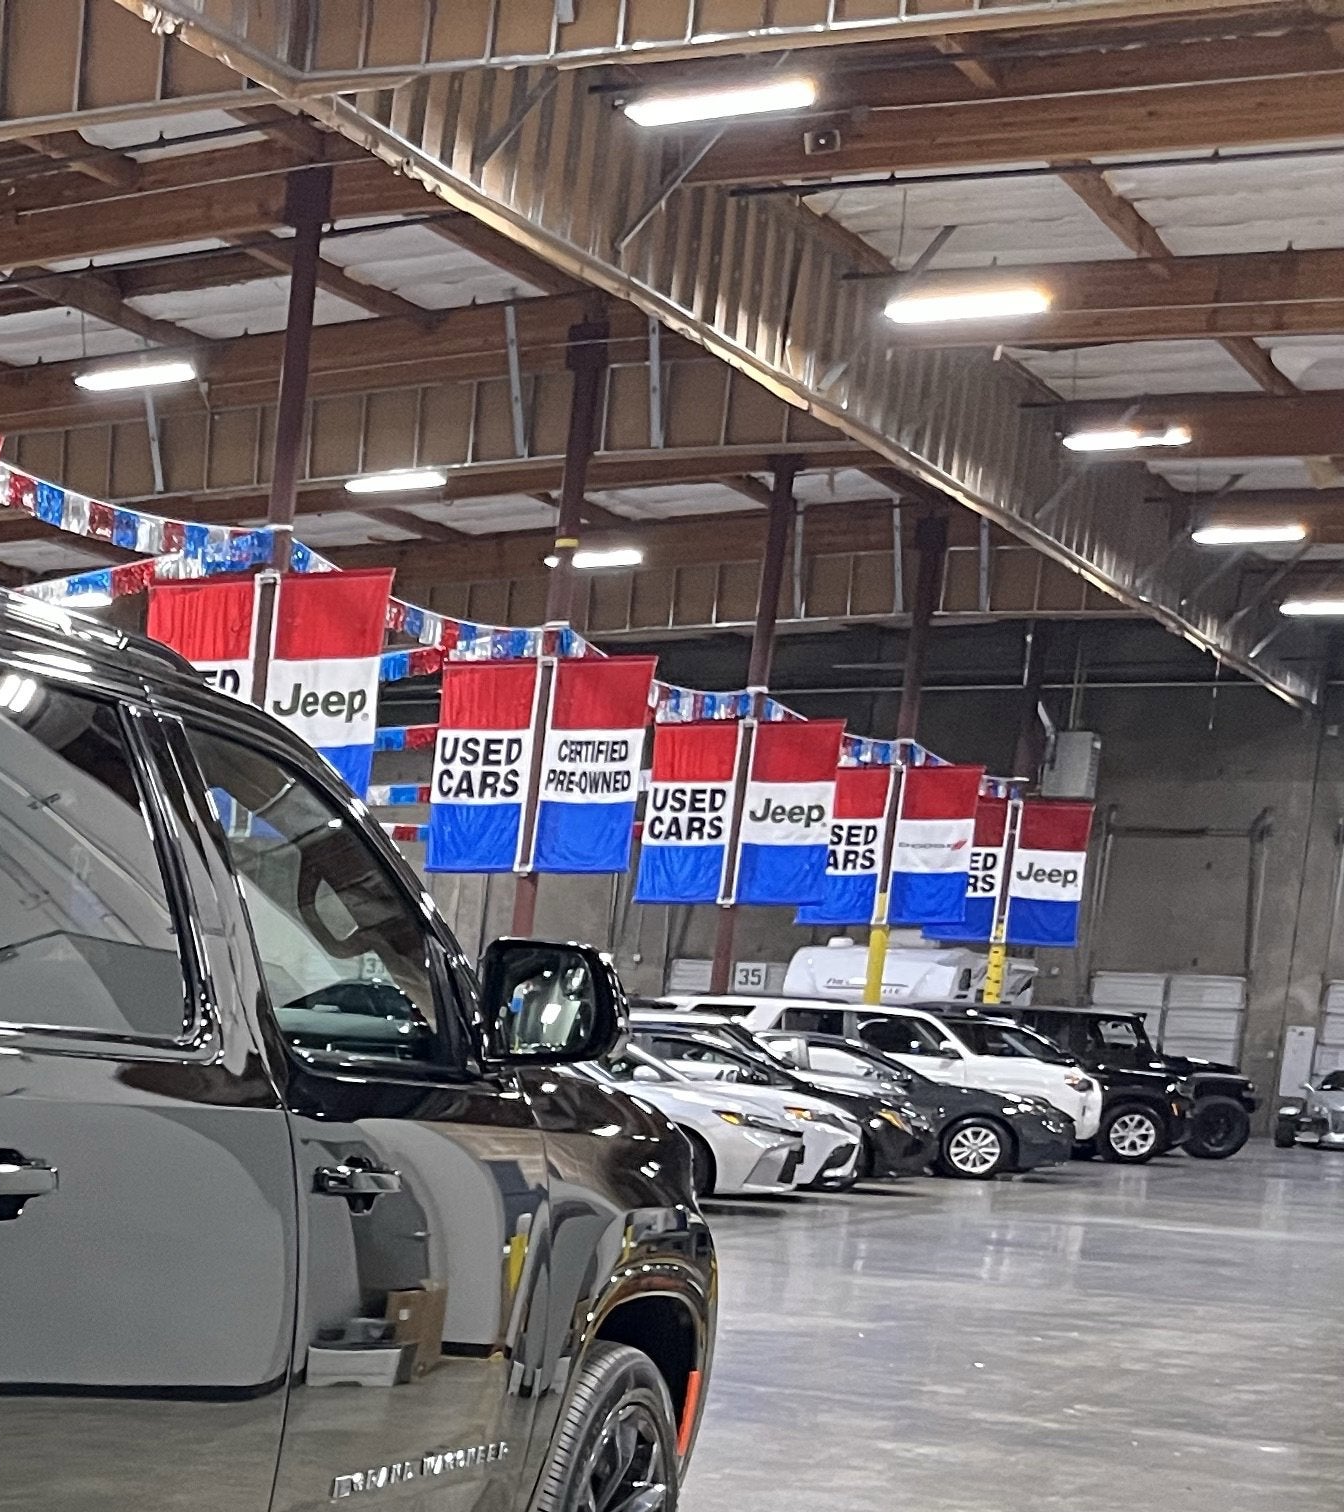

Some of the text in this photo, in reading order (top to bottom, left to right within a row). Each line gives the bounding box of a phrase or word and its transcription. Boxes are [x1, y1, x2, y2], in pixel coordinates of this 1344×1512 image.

[272, 683, 367, 723] Jeep
[440, 737, 522, 766] USED
[558, 739, 629, 763] CERTIFIED
[438, 769, 520, 798] CARS
[545, 769, 631, 794] PRE-OWNED
[652, 787, 727, 813] USED
[749, 798, 825, 828] Jeep
[648, 815, 723, 841] CARS
[830, 824, 878, 847] SED
[826, 848, 876, 871] ARS
[1017, 863, 1078, 888] Jeep
[738, 968, 762, 986] 35
